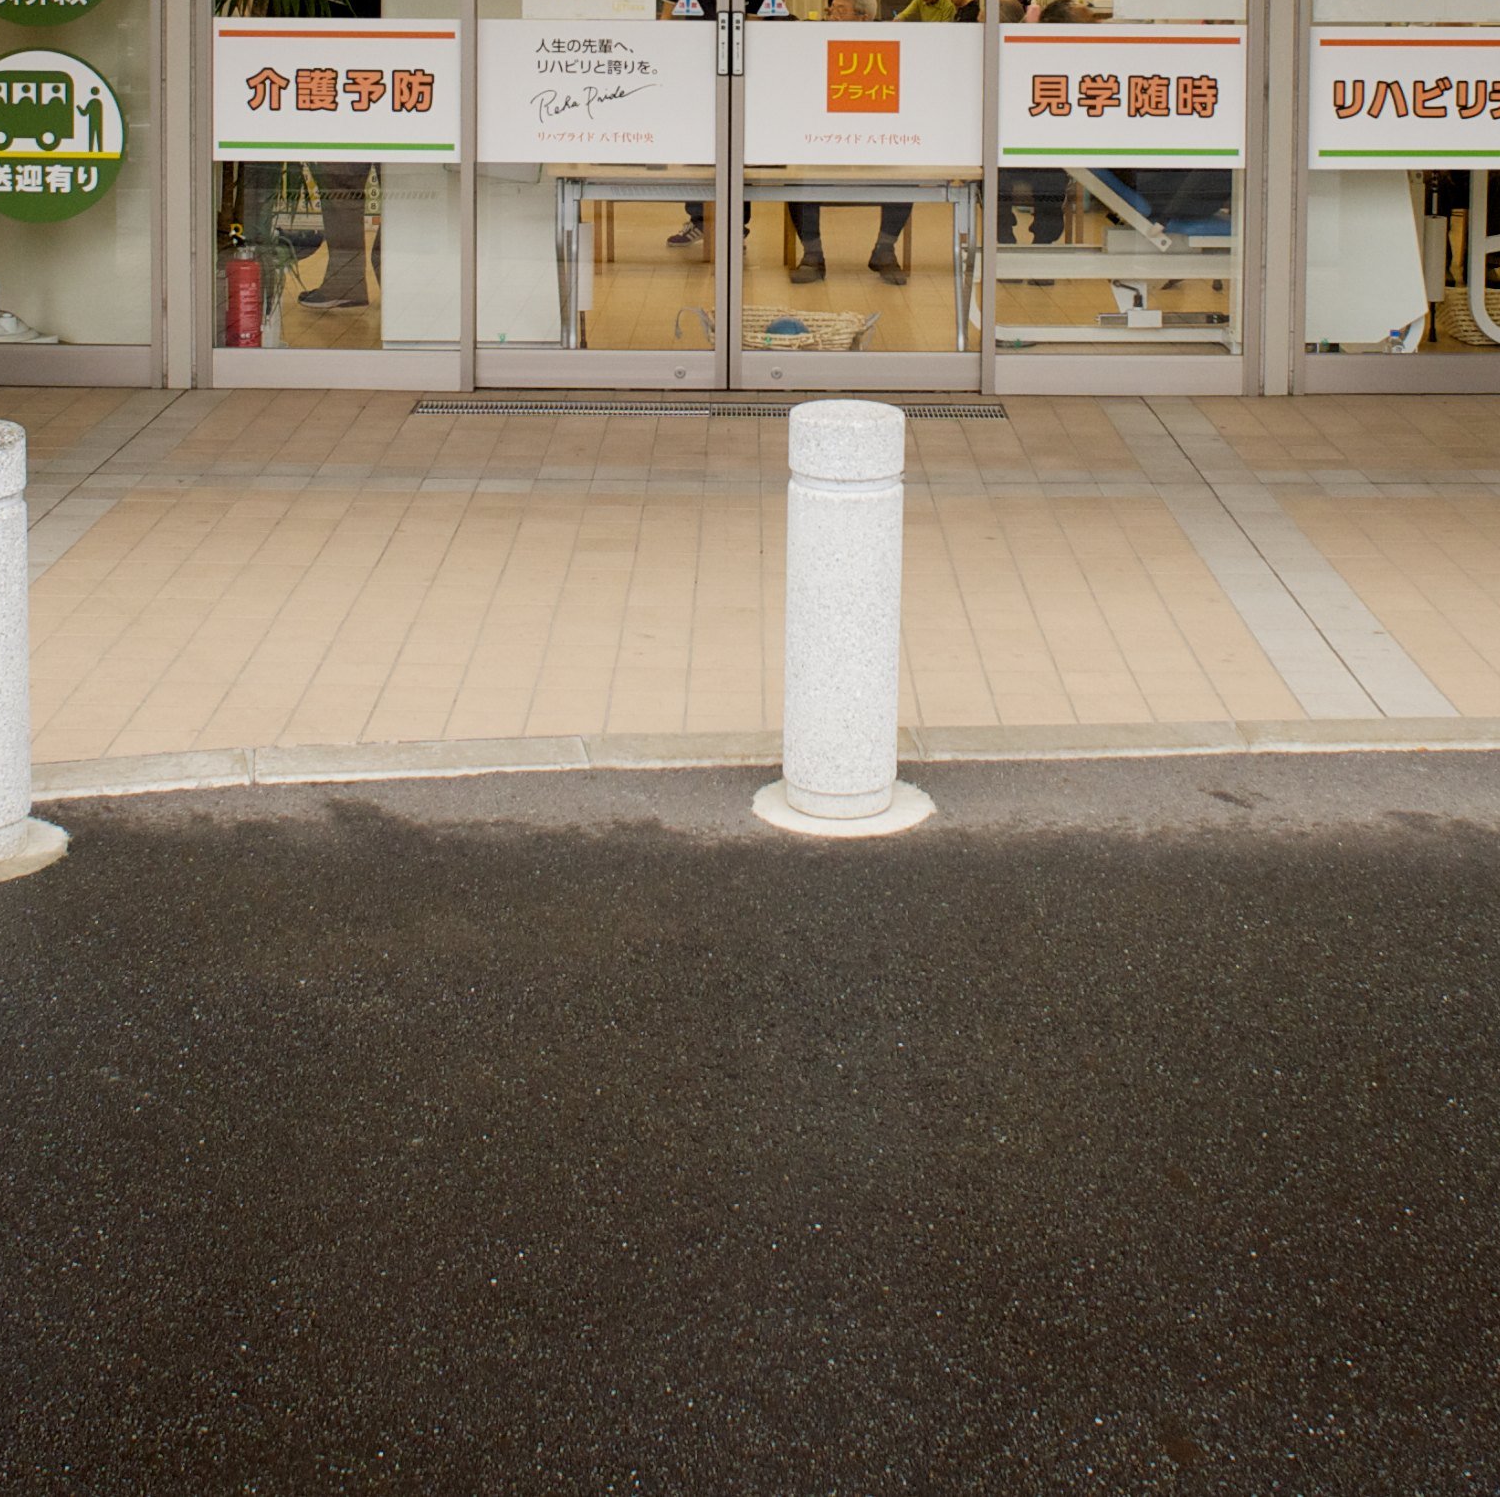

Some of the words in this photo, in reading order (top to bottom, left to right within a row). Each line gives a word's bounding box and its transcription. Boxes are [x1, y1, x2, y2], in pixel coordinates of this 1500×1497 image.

[536, 39, 634, 53] 人生の先輩へ、
[537, 59, 658, 75] リハビリと誇りを。
[839, 53, 887, 75] リハ
[246, 67, 435, 112] 介護予防
[830, 83, 896, 100] プライド
[1028, 74, 1218, 118] 見学随時
[530, 89, 580, 123] Reha
[583, 84, 658, 119] Pride
[600, 132, 654, 143] 八千代中央
